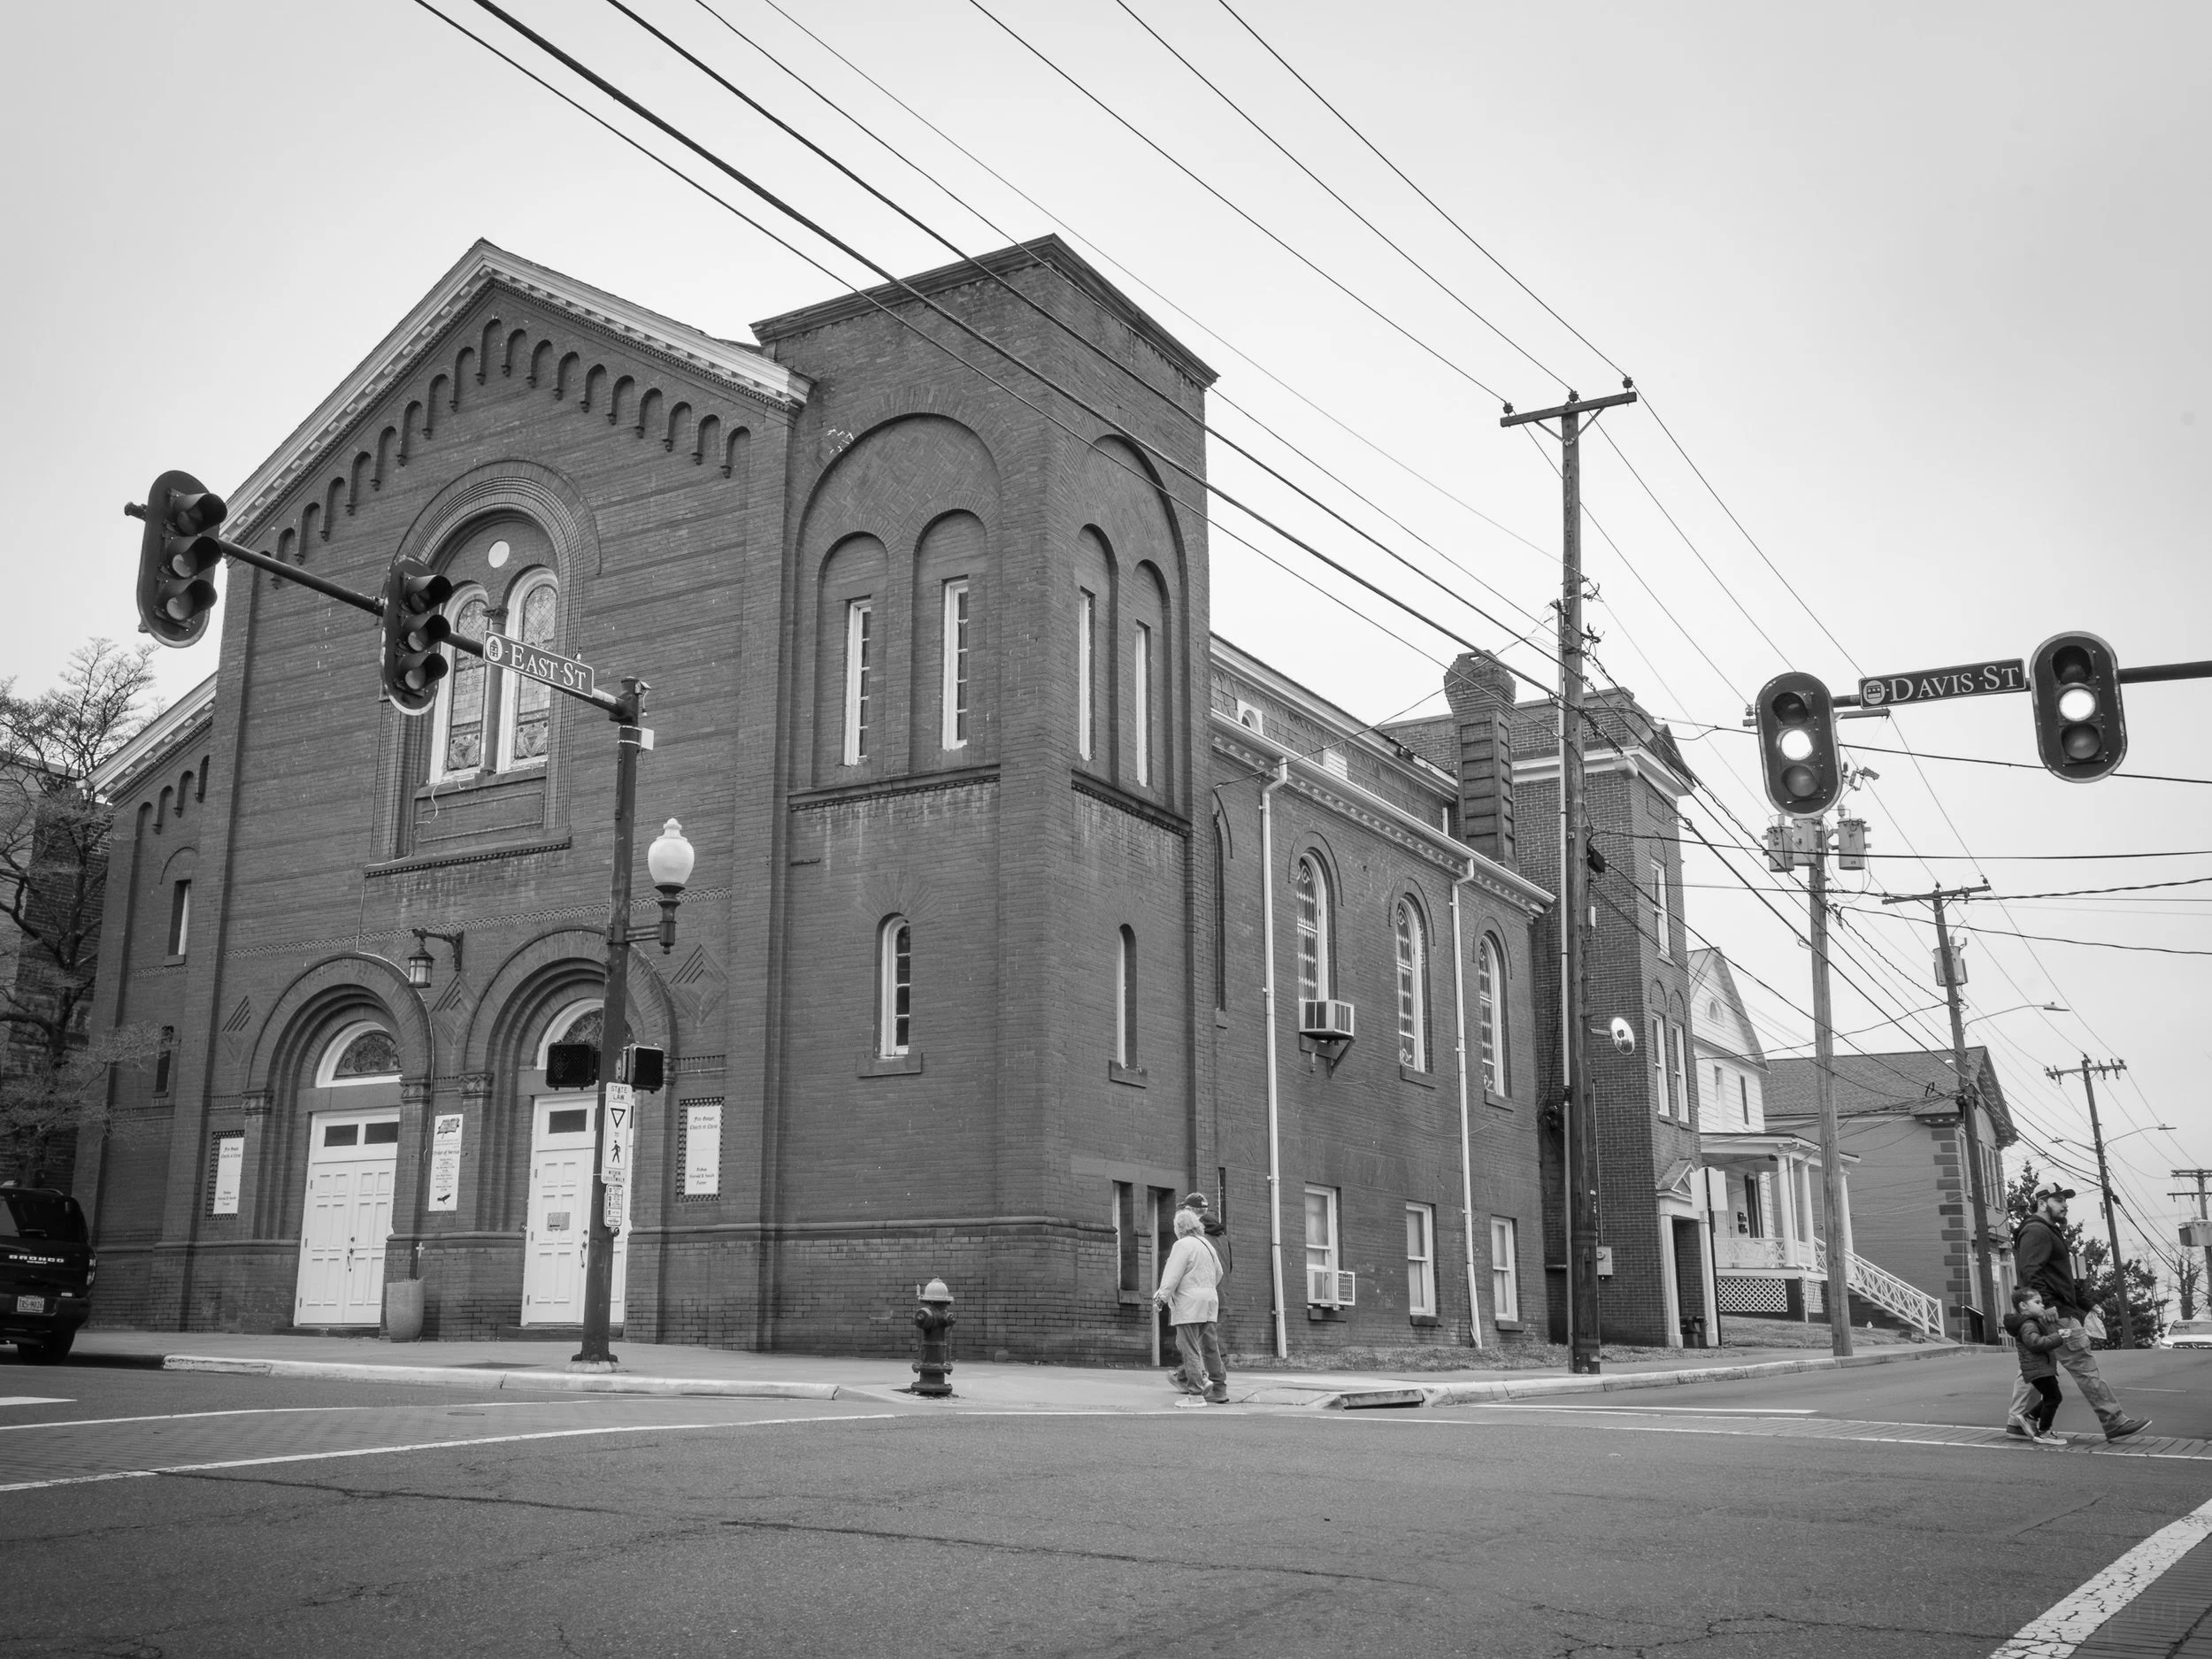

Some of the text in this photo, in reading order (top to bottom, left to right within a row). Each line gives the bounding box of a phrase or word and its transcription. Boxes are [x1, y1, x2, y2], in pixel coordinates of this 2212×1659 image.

[510, 643, 587, 690] EAST ST
[1888, 665, 2020, 703] DAVIS ST
[611, 1085, 627, 1094] STATE
